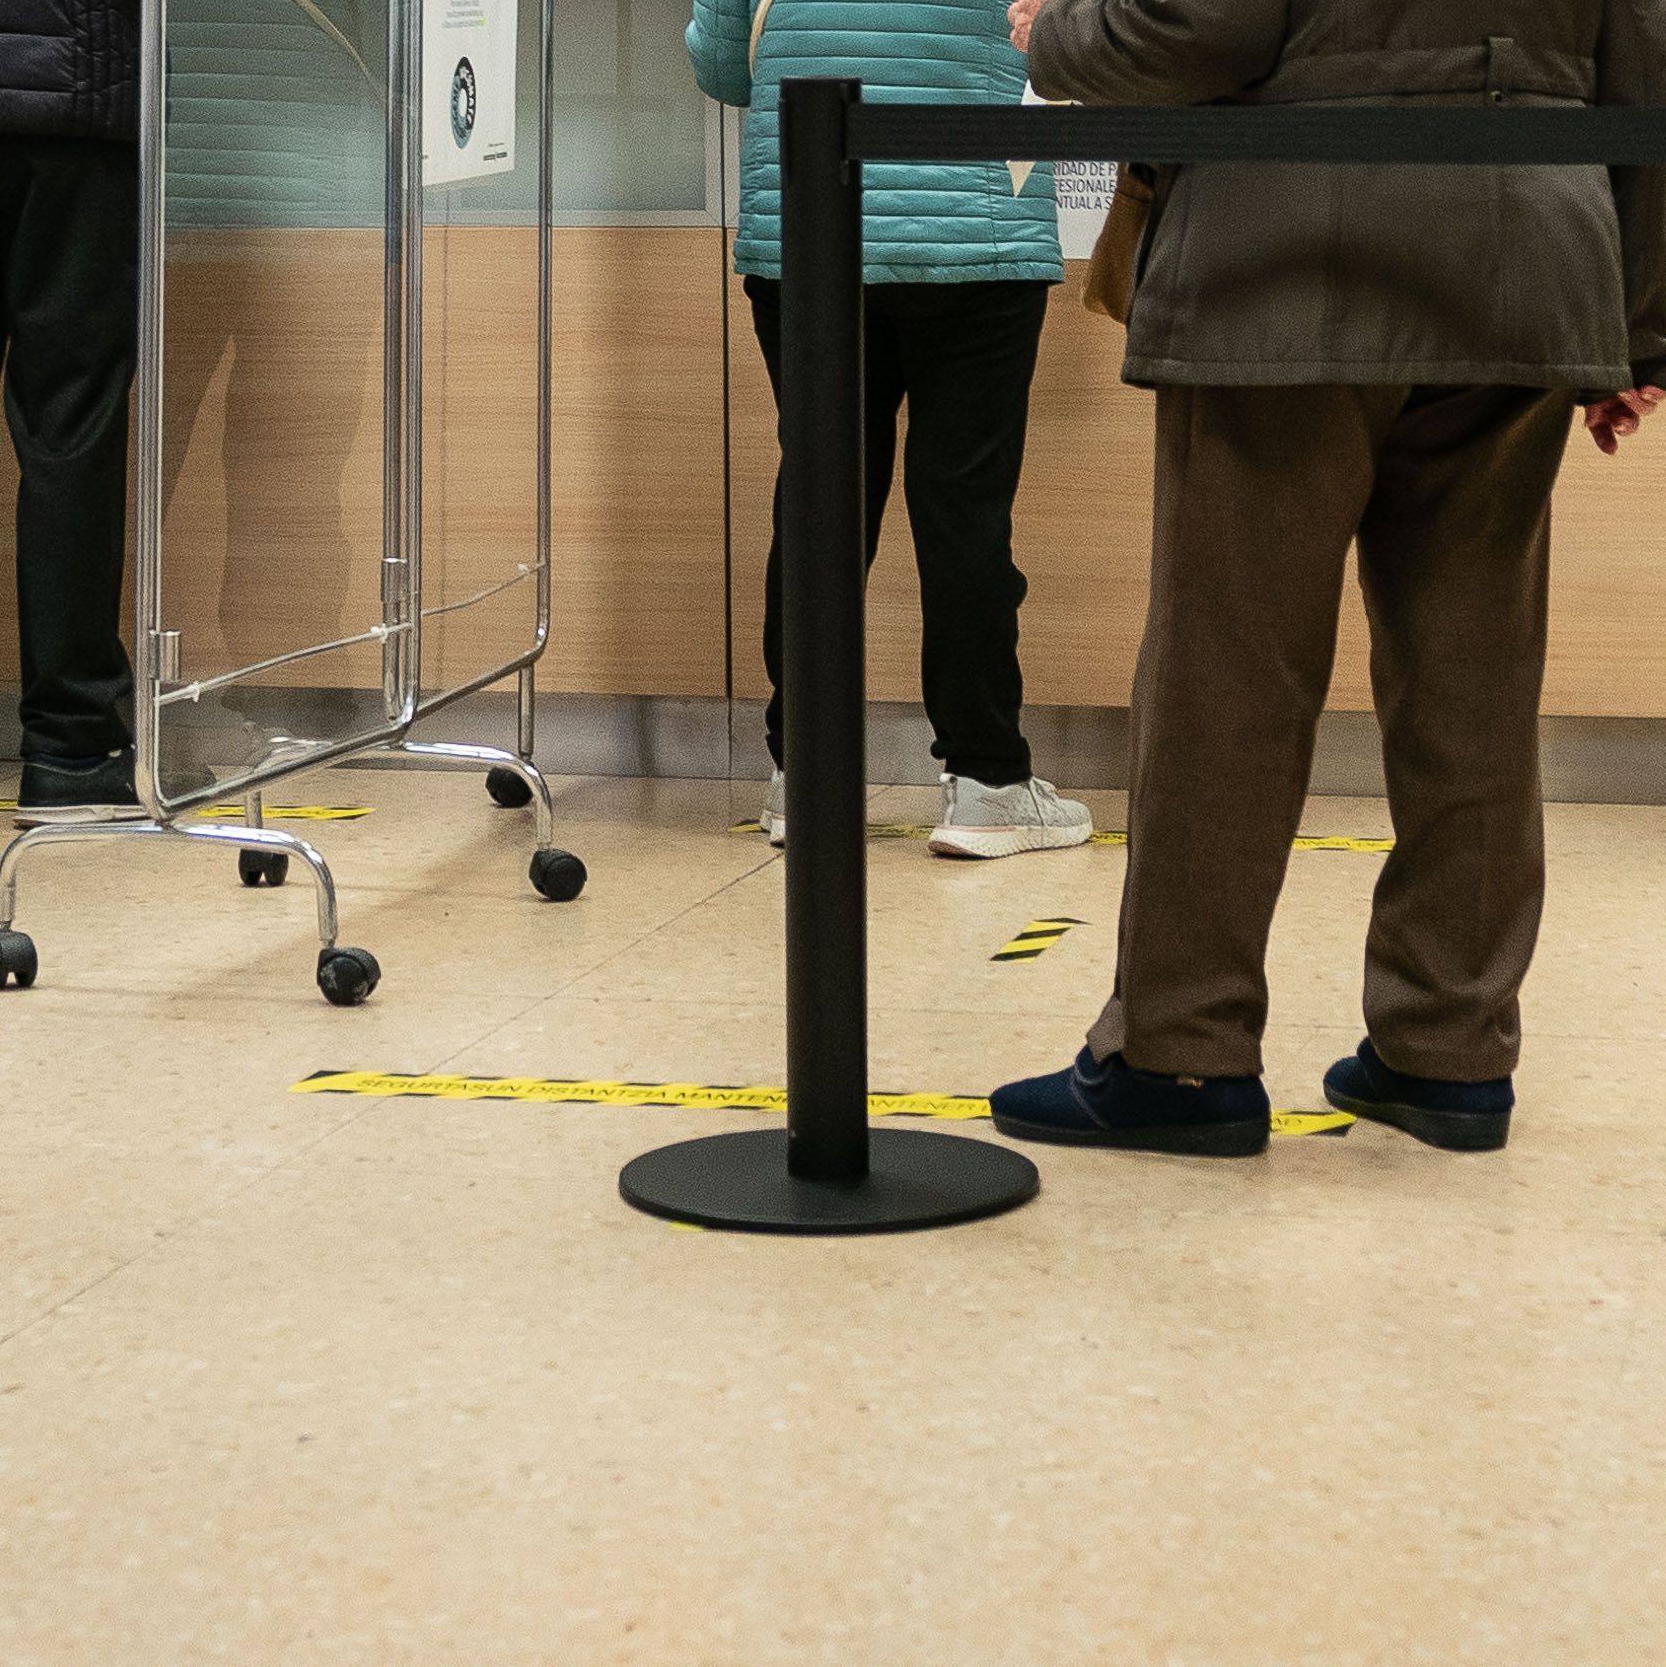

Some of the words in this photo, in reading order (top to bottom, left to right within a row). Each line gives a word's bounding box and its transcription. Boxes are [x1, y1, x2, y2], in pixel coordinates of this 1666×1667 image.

[1089, 162, 1106, 176] DE
[356, 1078, 520, 1093] SEGURTASUN
[525, 1084, 669, 1098] DISTANTZIA
